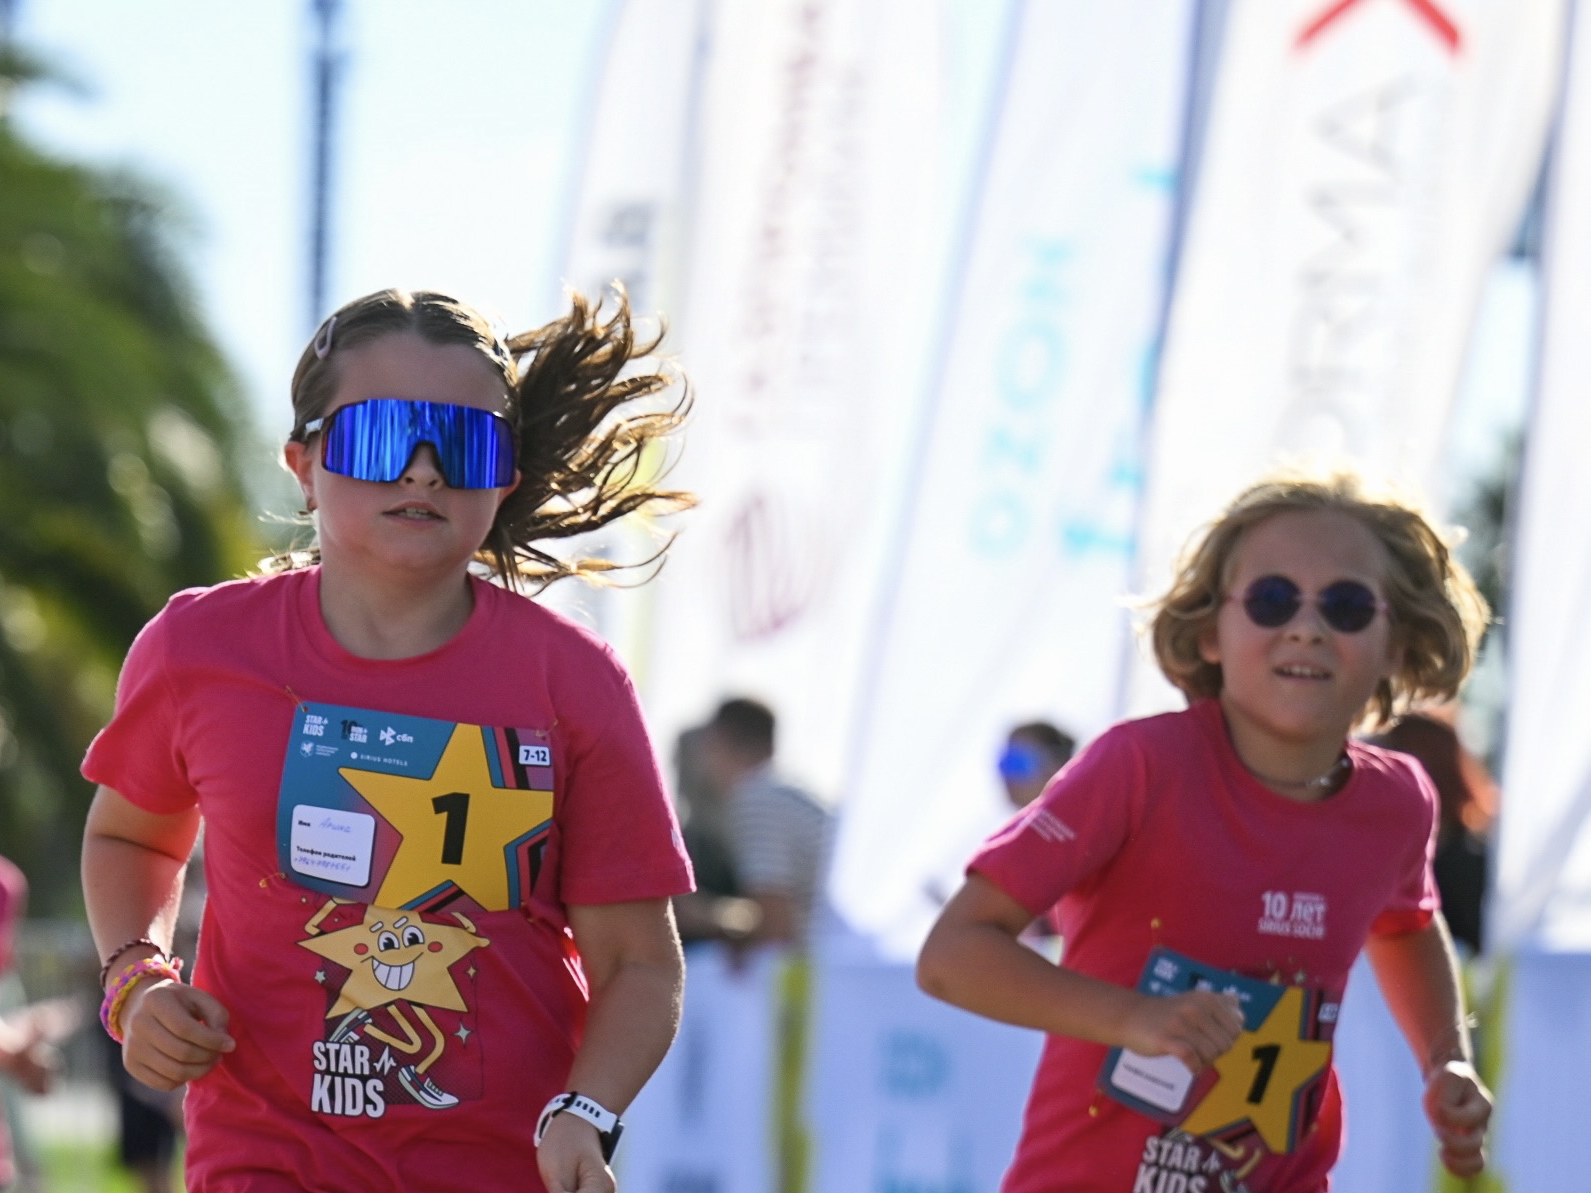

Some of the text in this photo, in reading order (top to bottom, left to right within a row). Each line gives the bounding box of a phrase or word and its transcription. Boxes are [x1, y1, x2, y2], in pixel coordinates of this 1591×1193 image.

[303, 723, 324, 736] KIDS
[524, 749, 547, 762] 7-12
[431, 792, 470, 865] 1
[1261, 891, 1287, 920] 10
[312, 1041, 370, 1075] STAR
[1246, 1044, 1281, 1105] 1
[311, 1073, 385, 1118] KIDS
[1142, 1135, 1201, 1173] STAR
